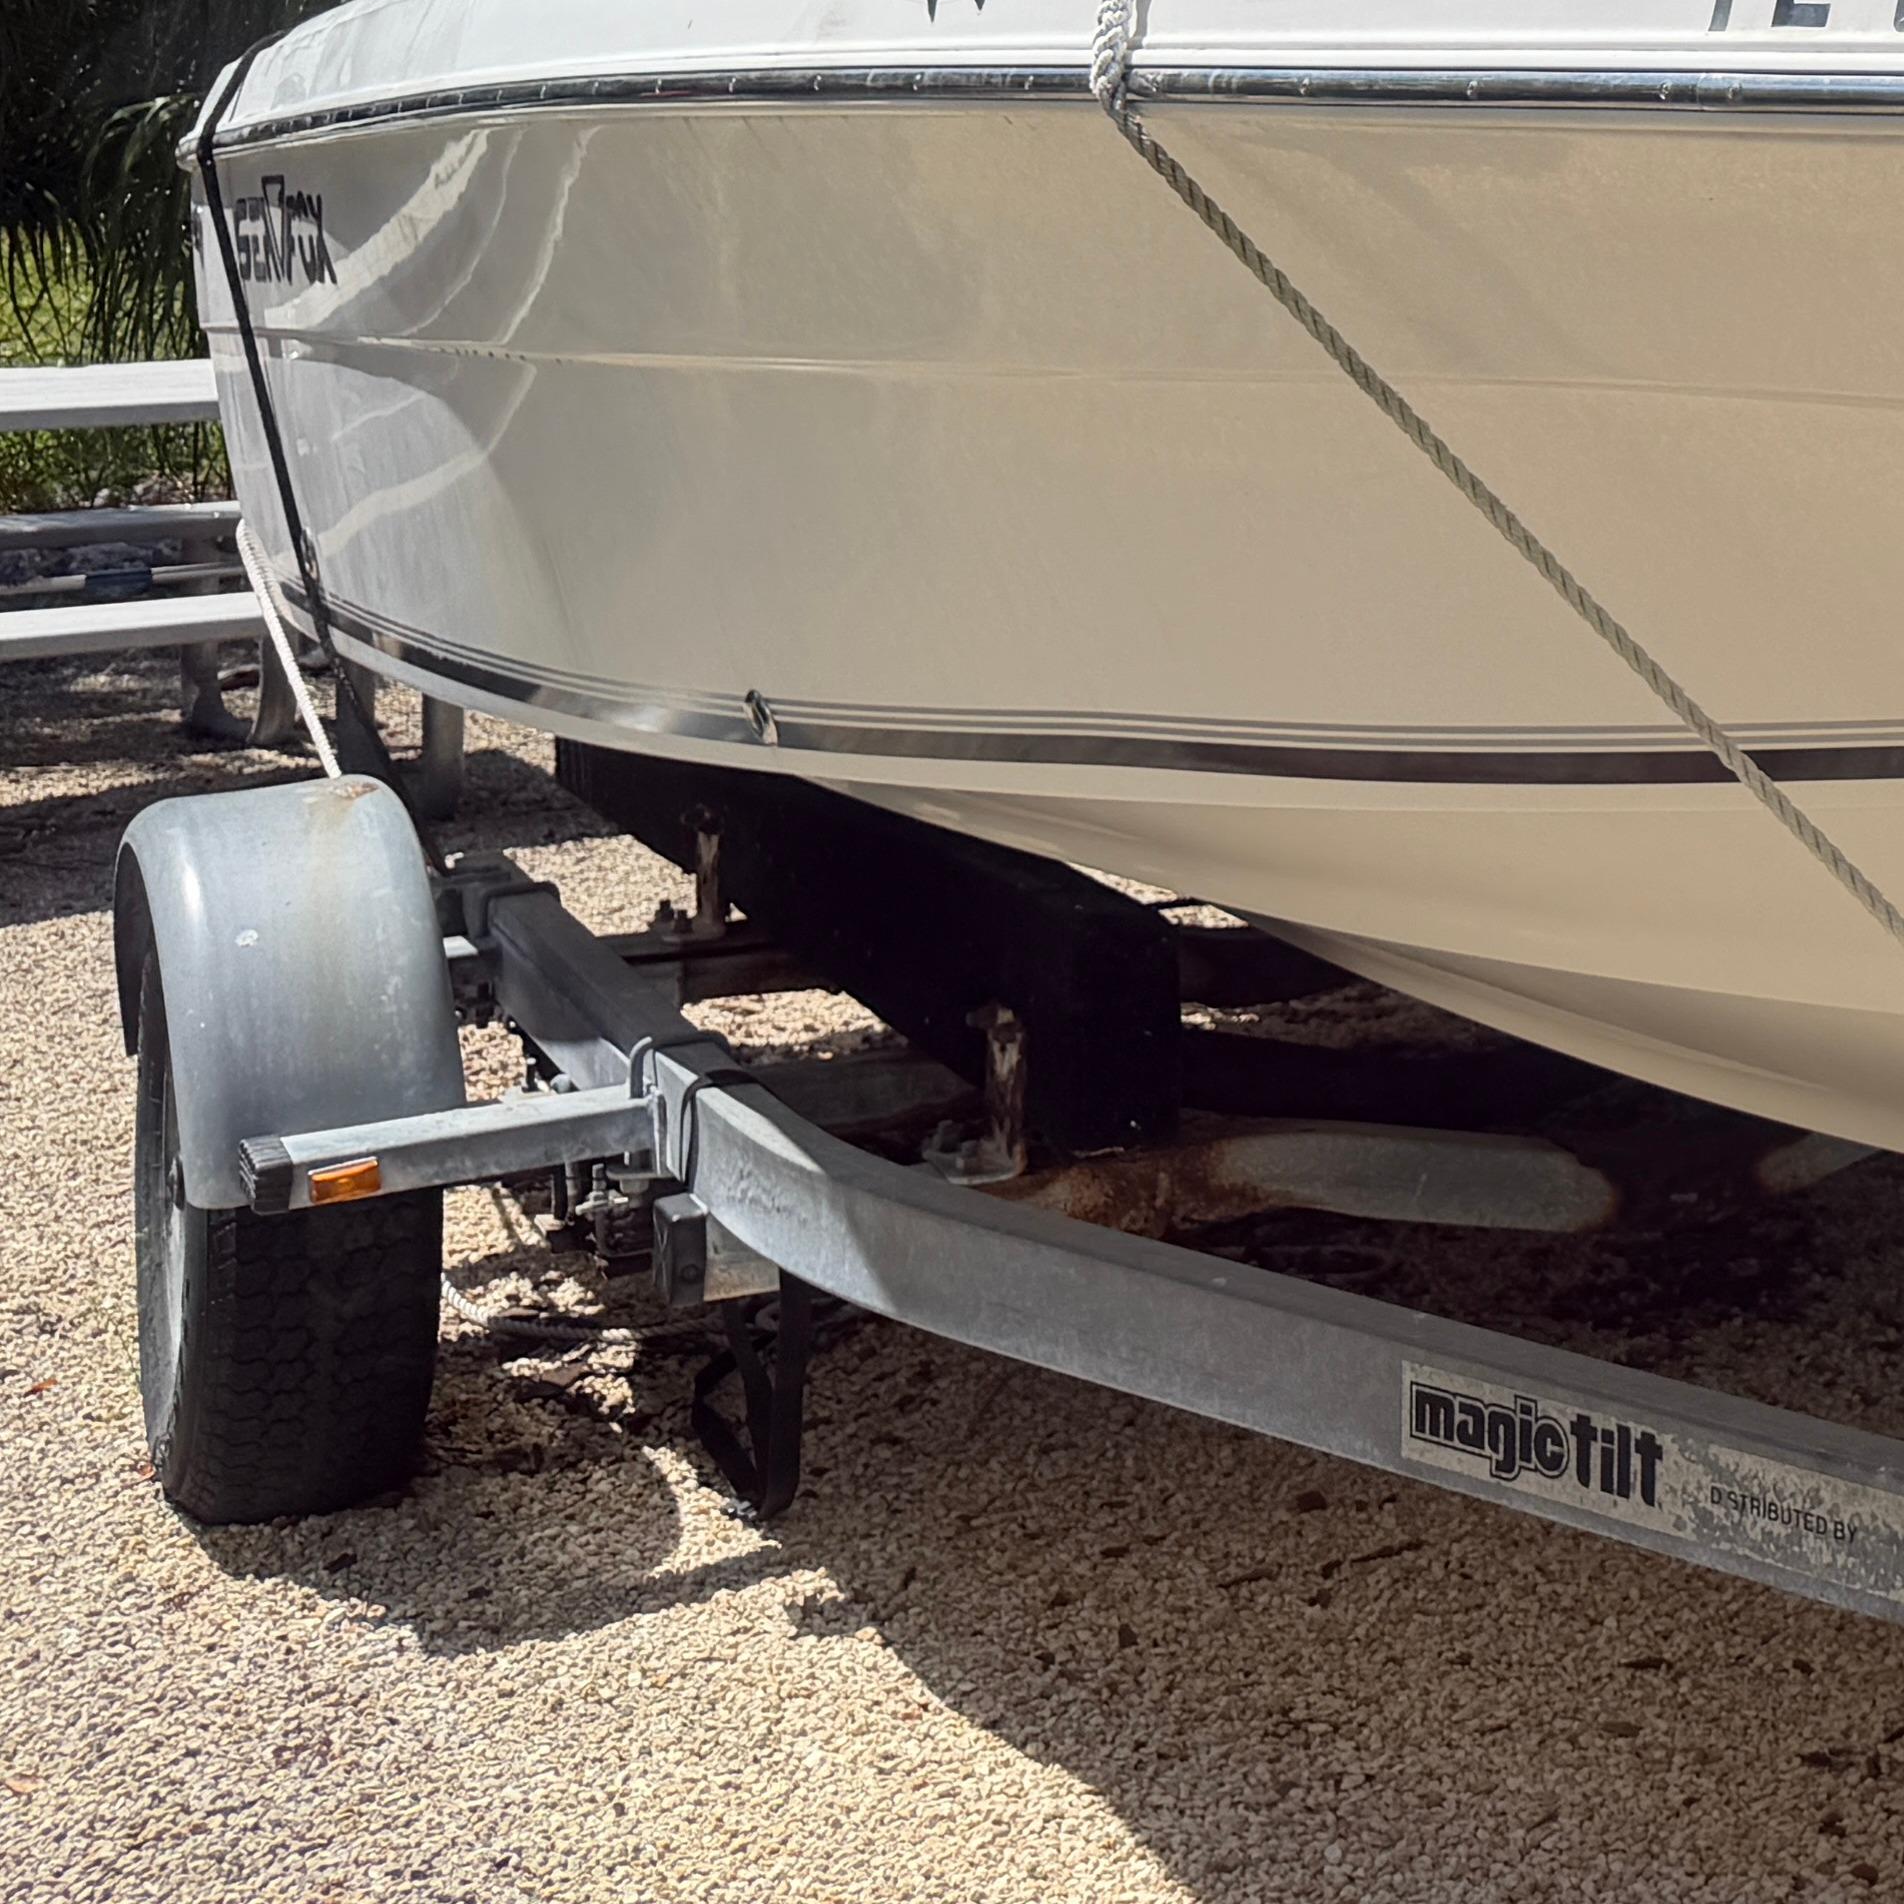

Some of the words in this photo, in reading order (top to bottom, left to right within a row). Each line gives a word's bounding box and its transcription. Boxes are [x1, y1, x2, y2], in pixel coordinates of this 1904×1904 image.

[1410, 1380, 1569, 1482] magic
[1570, 1412, 1663, 1508] tilt
[1710, 1485, 1828, 1536] DSTRIBUTED
[1832, 1520, 1858, 1544] BY
